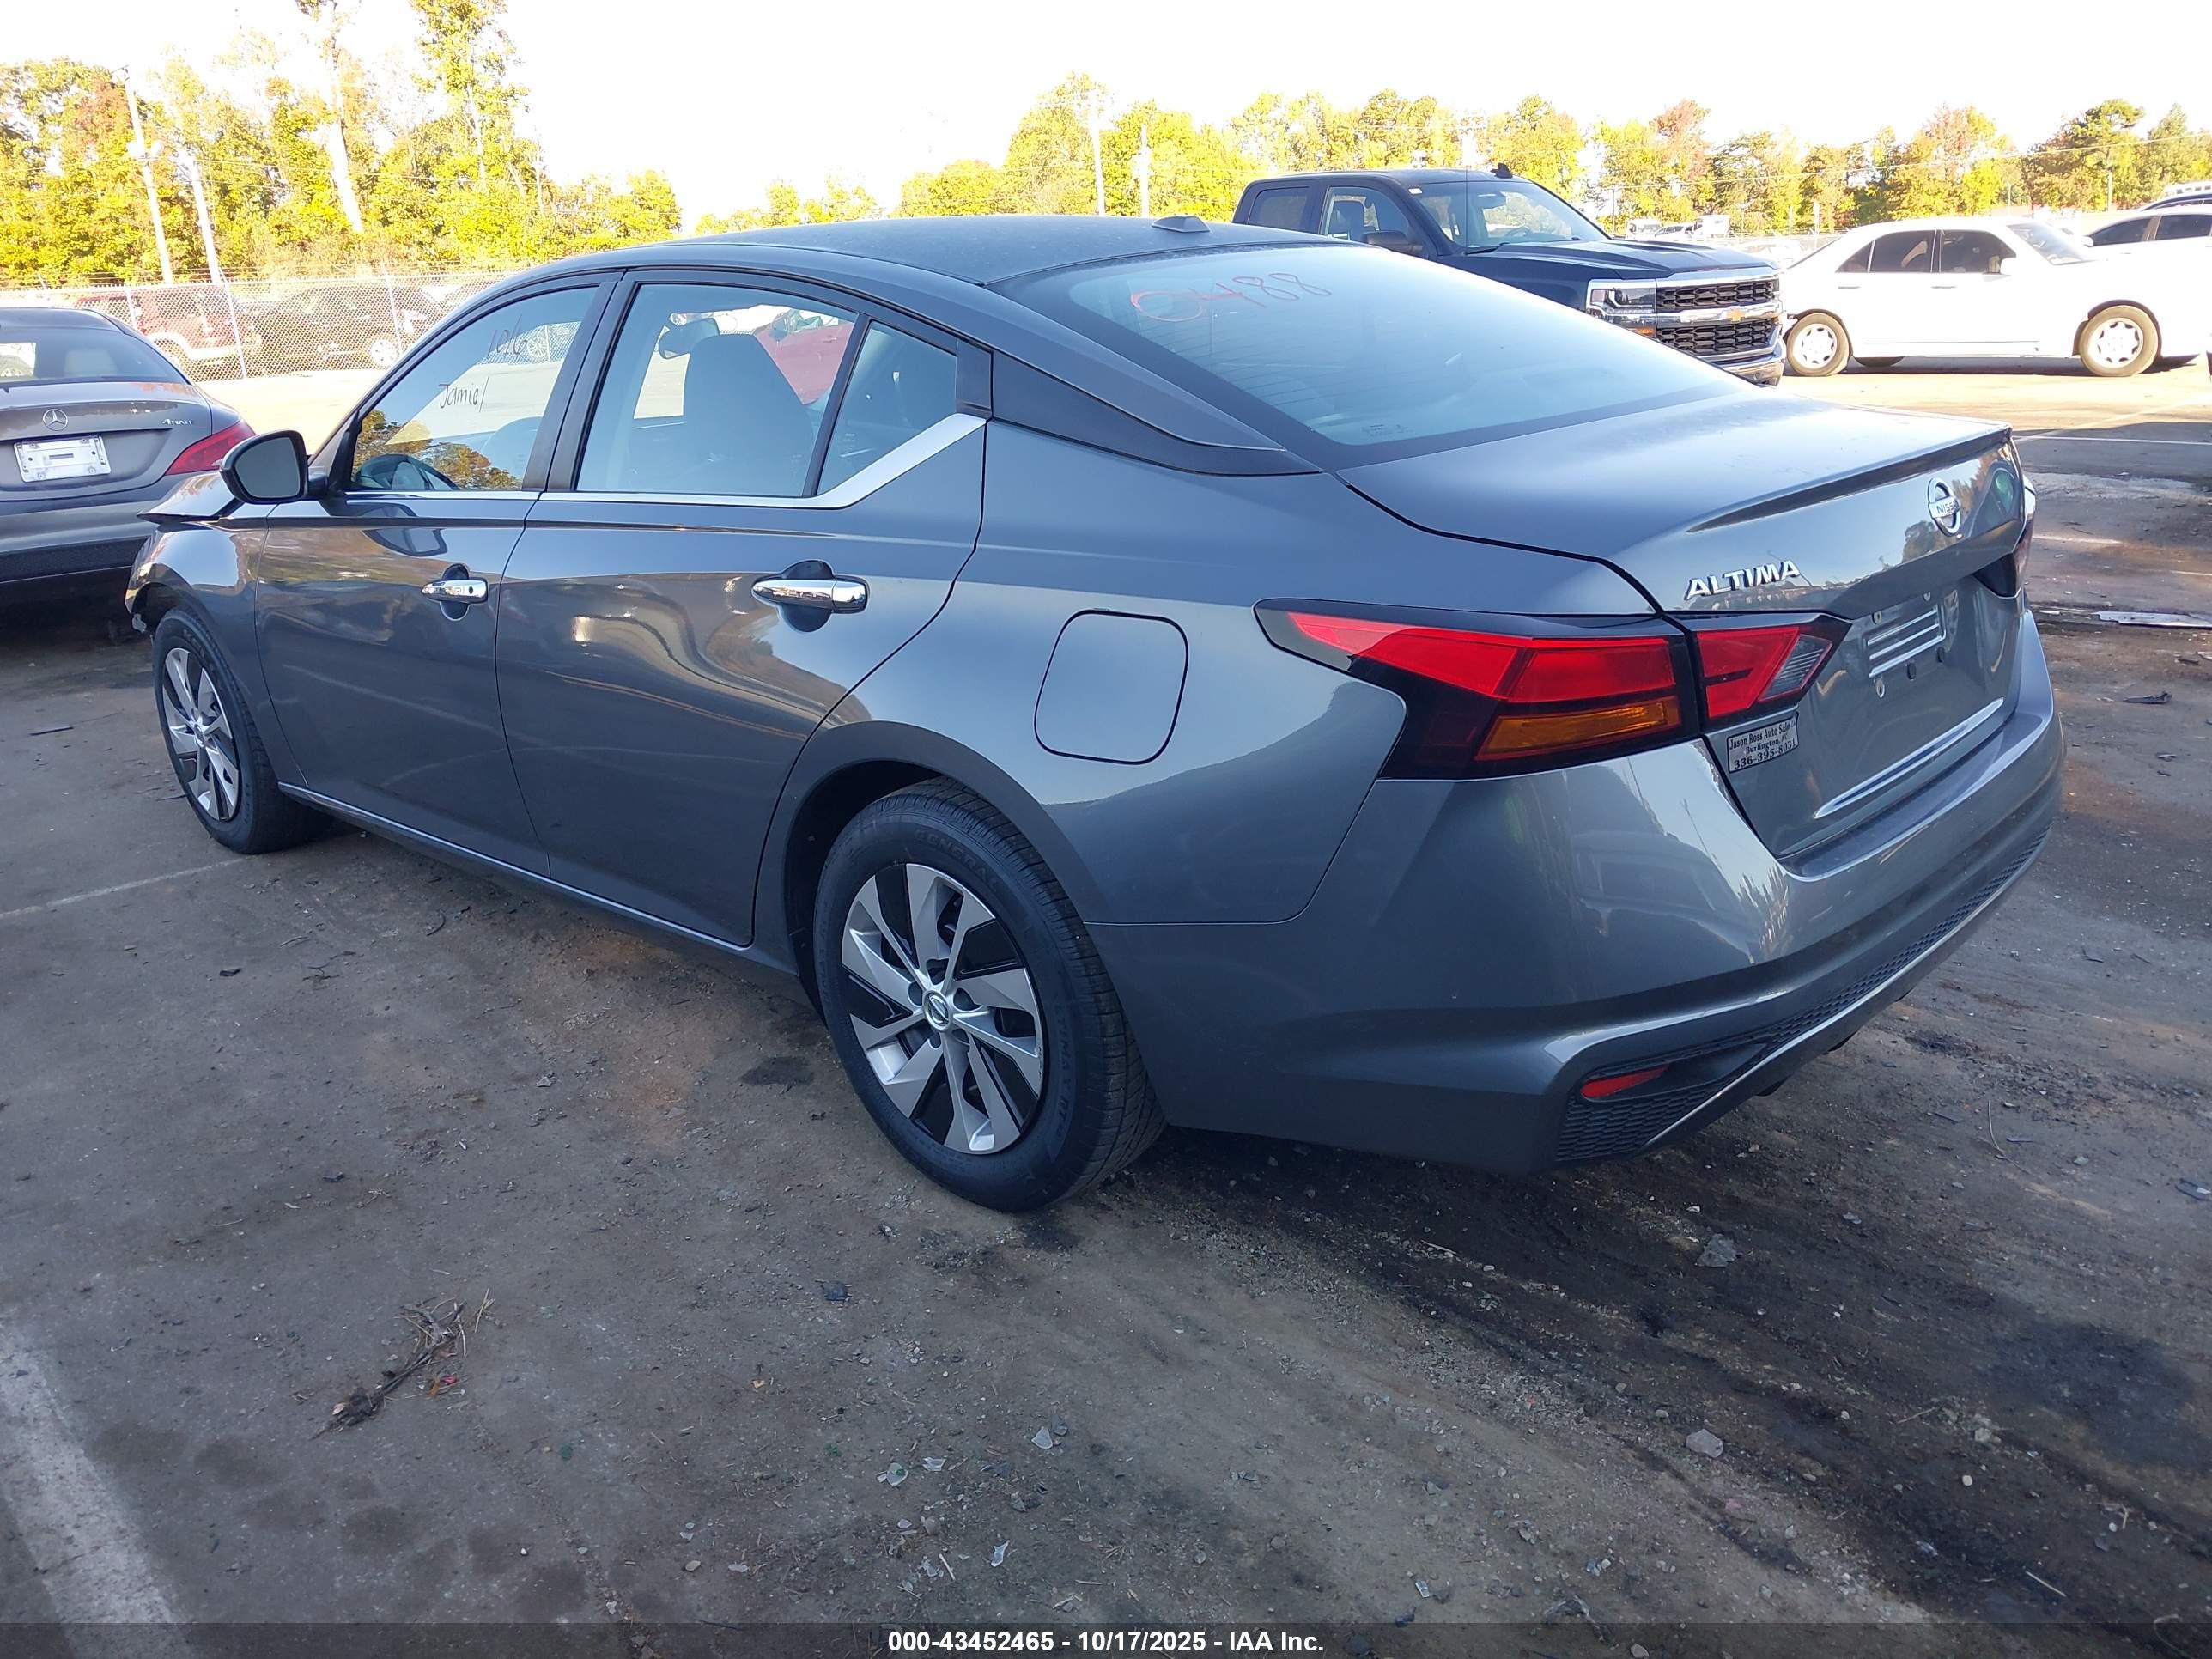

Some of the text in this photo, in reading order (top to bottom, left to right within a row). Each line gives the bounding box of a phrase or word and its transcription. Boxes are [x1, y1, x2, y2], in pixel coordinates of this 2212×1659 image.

[1130, 273, 1332, 322] 0488
[1683, 560, 1801, 600] ALTIMA
[1729, 738, 1748, 750] Jason
[1748, 732, 1763, 744] Ross
[1764, 726, 1778, 738] Auto
[1734, 738, 1796, 769] 336-395-8031
